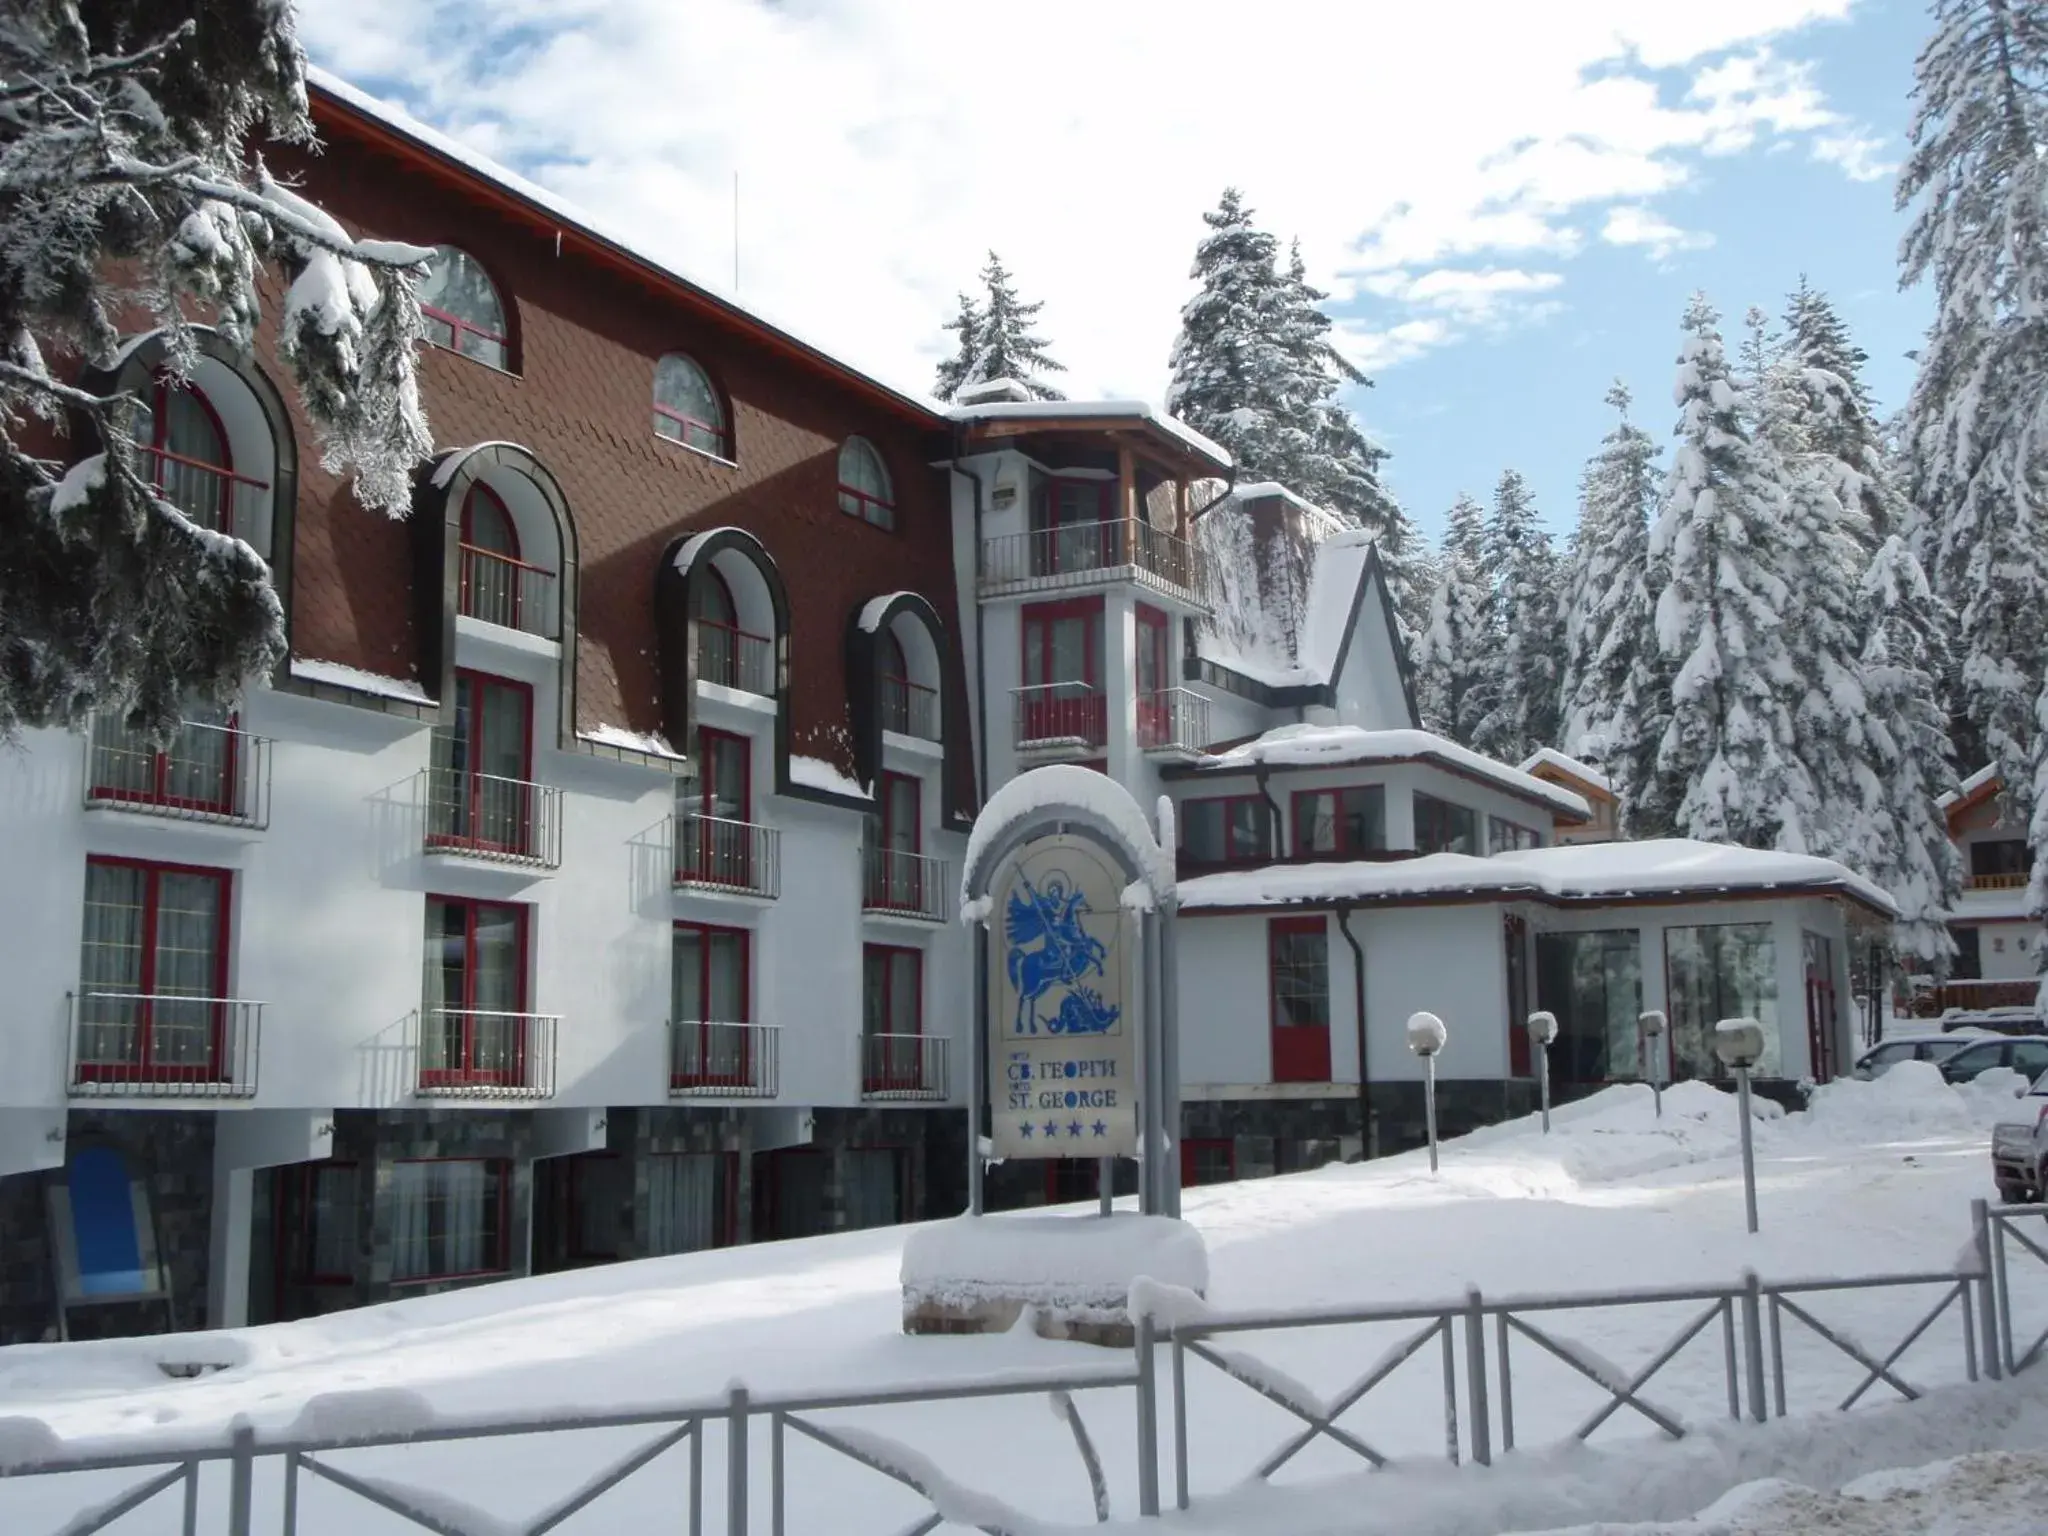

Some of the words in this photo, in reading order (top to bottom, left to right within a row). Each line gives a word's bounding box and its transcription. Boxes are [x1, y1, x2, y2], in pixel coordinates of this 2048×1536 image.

[1040, 1060, 1116, 1080] ГЕОРГИ
[1008, 1092, 1033, 1110] ST.
[1039, 1089, 1117, 1110] GEORGE
